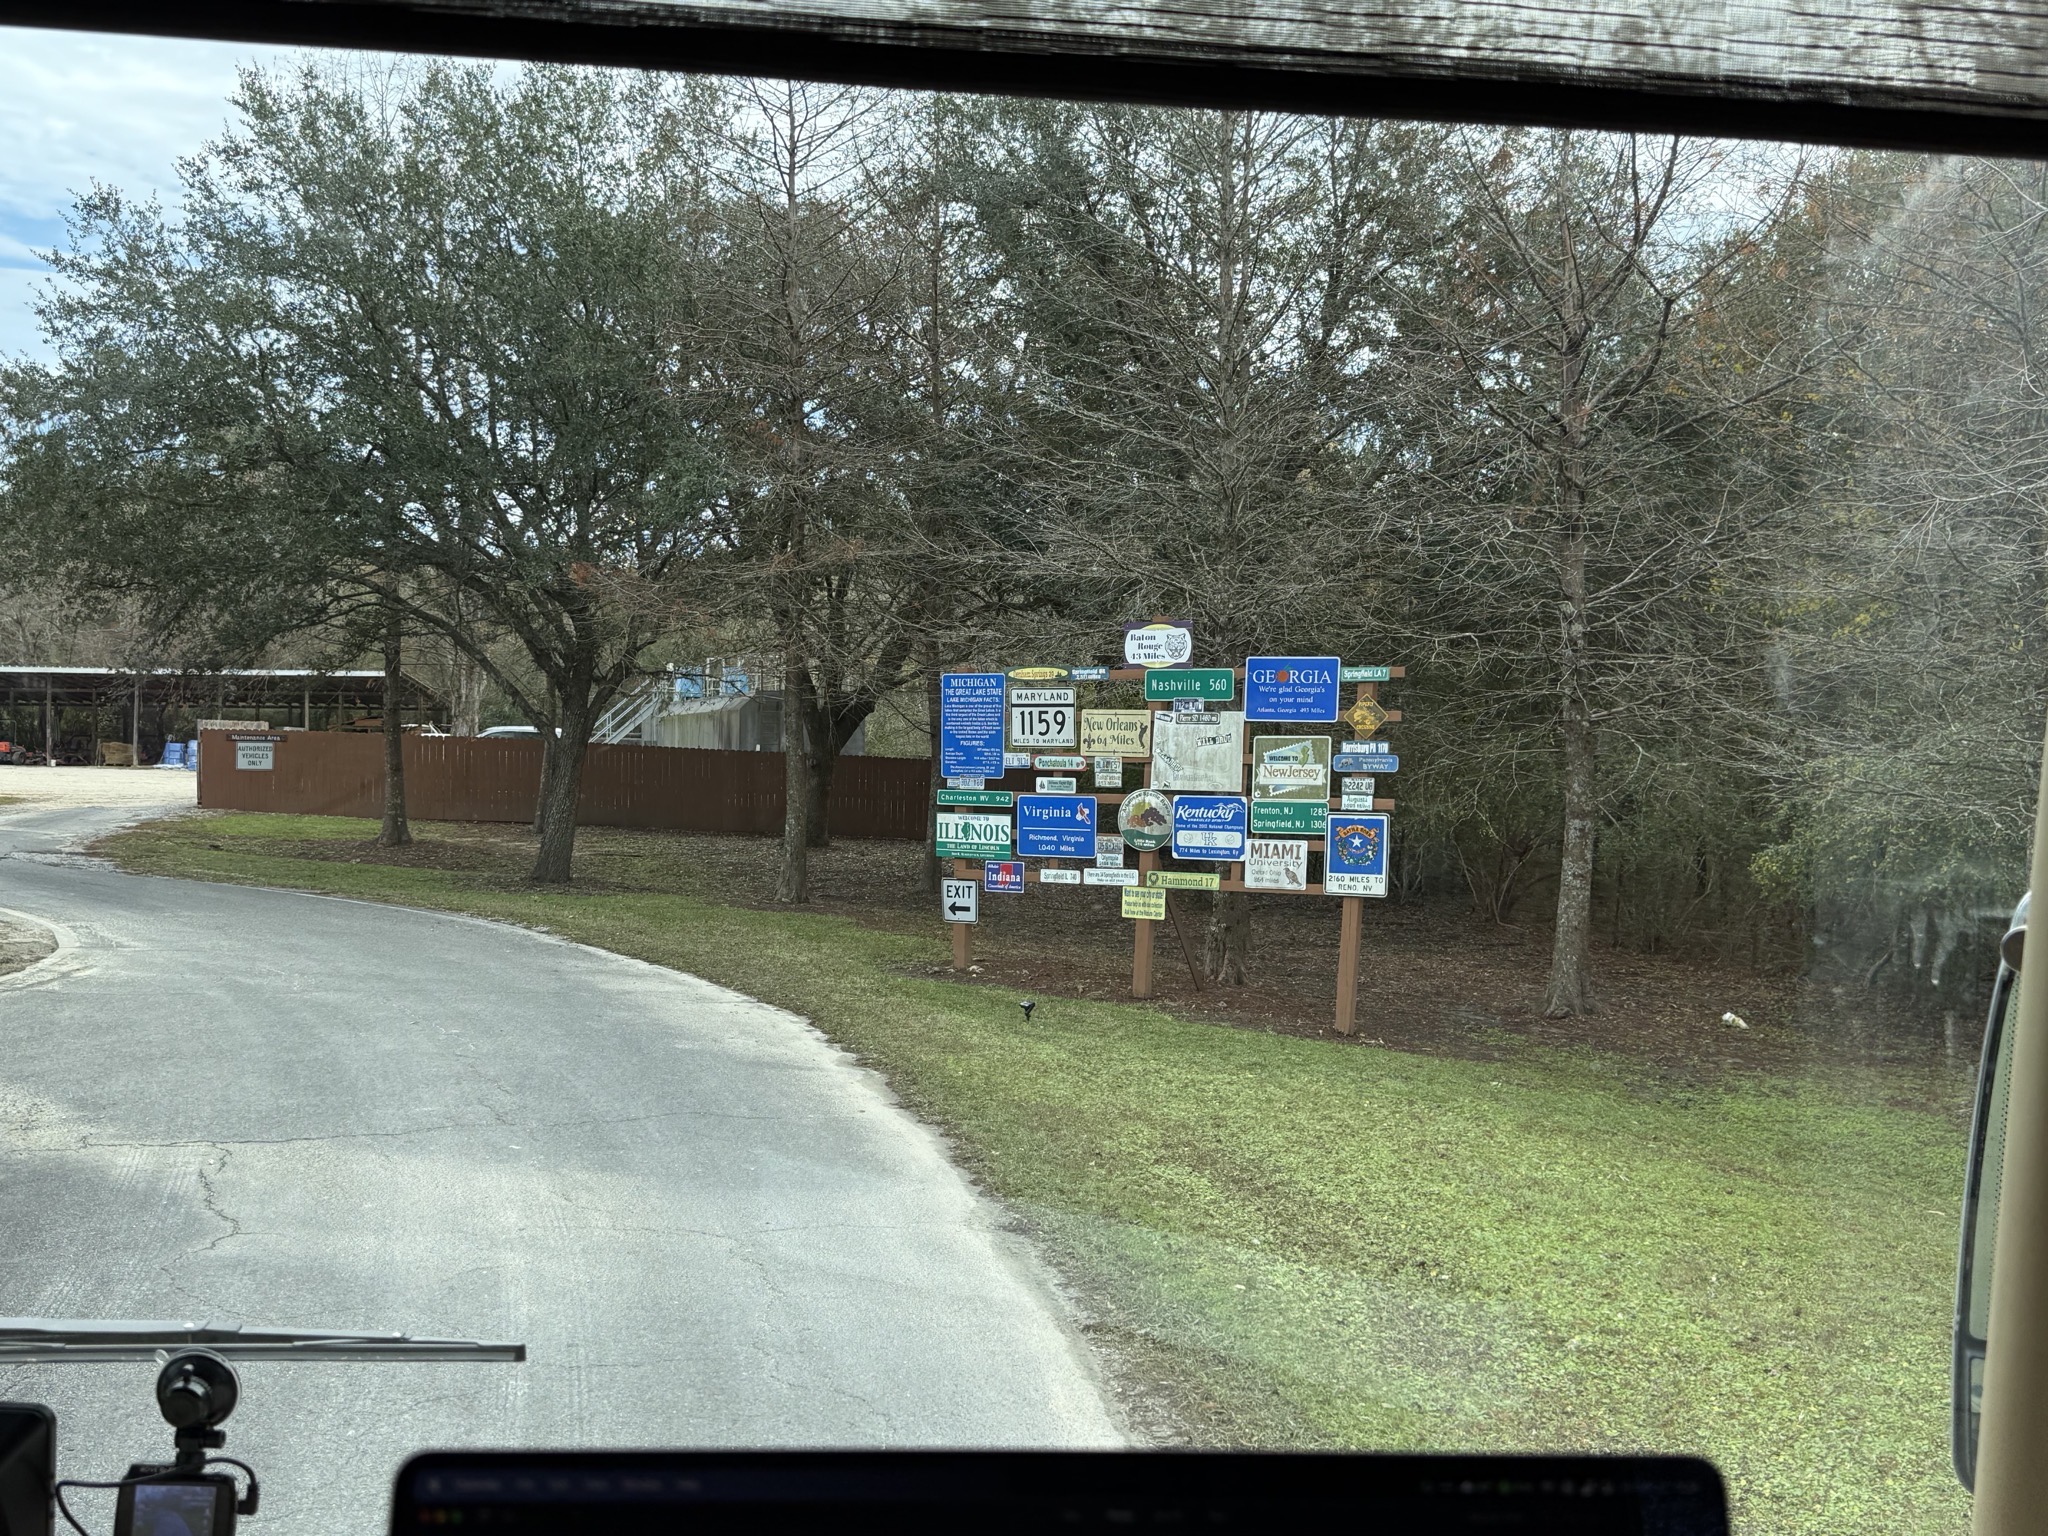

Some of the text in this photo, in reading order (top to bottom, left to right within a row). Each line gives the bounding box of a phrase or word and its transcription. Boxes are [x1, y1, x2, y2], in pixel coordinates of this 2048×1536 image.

[1130, 634, 1156, 642] Baton
[1137, 642, 1163, 651] Rouge
[1253, 669, 1332, 684] GEORGIA
[1343, 669, 1373, 679] Springfield
[951, 678, 997, 687] MICHIGAN
[1151, 679, 1227, 691] Nashville 560
[945, 688, 1003, 696] THE GREAT LAKE STATE
[1278, 686, 1292, 694] glad
[1294, 686, 1325, 695] Georgia's
[1016, 692, 1069, 702] MARYLAND
[1020, 710, 1066, 736] 1159
[1084, 717, 1103, 732] New
[1105, 717, 1138, 732] Orleans
[1096, 735, 1134, 746] 64 Miles
[1342, 742, 1370, 754] Harrisburg
[1038, 758, 1067, 768] Ponchatoula
[1023, 805, 1071, 821] Virginia
[1175, 805, 1235, 822] Kentucky
[1253, 807, 1327, 816] Trenton, NJ 1283
[1253, 820, 1295, 829] Springfield,
[1062, 834, 1084, 843] Virginia
[1201, 832, 1218, 846] UK
[1059, 844, 1075, 852] Miles
[1250, 842, 1302, 860] MIAMI
[1248, 859, 1303, 869] University
[988, 871, 1021, 882] Indiana
[1043, 872, 1065, 881] Springfield
[1161, 876, 1214, 887] Hammond 17
[1328, 875, 1345, 883] 2160
[947, 885, 973, 899] EXIT
